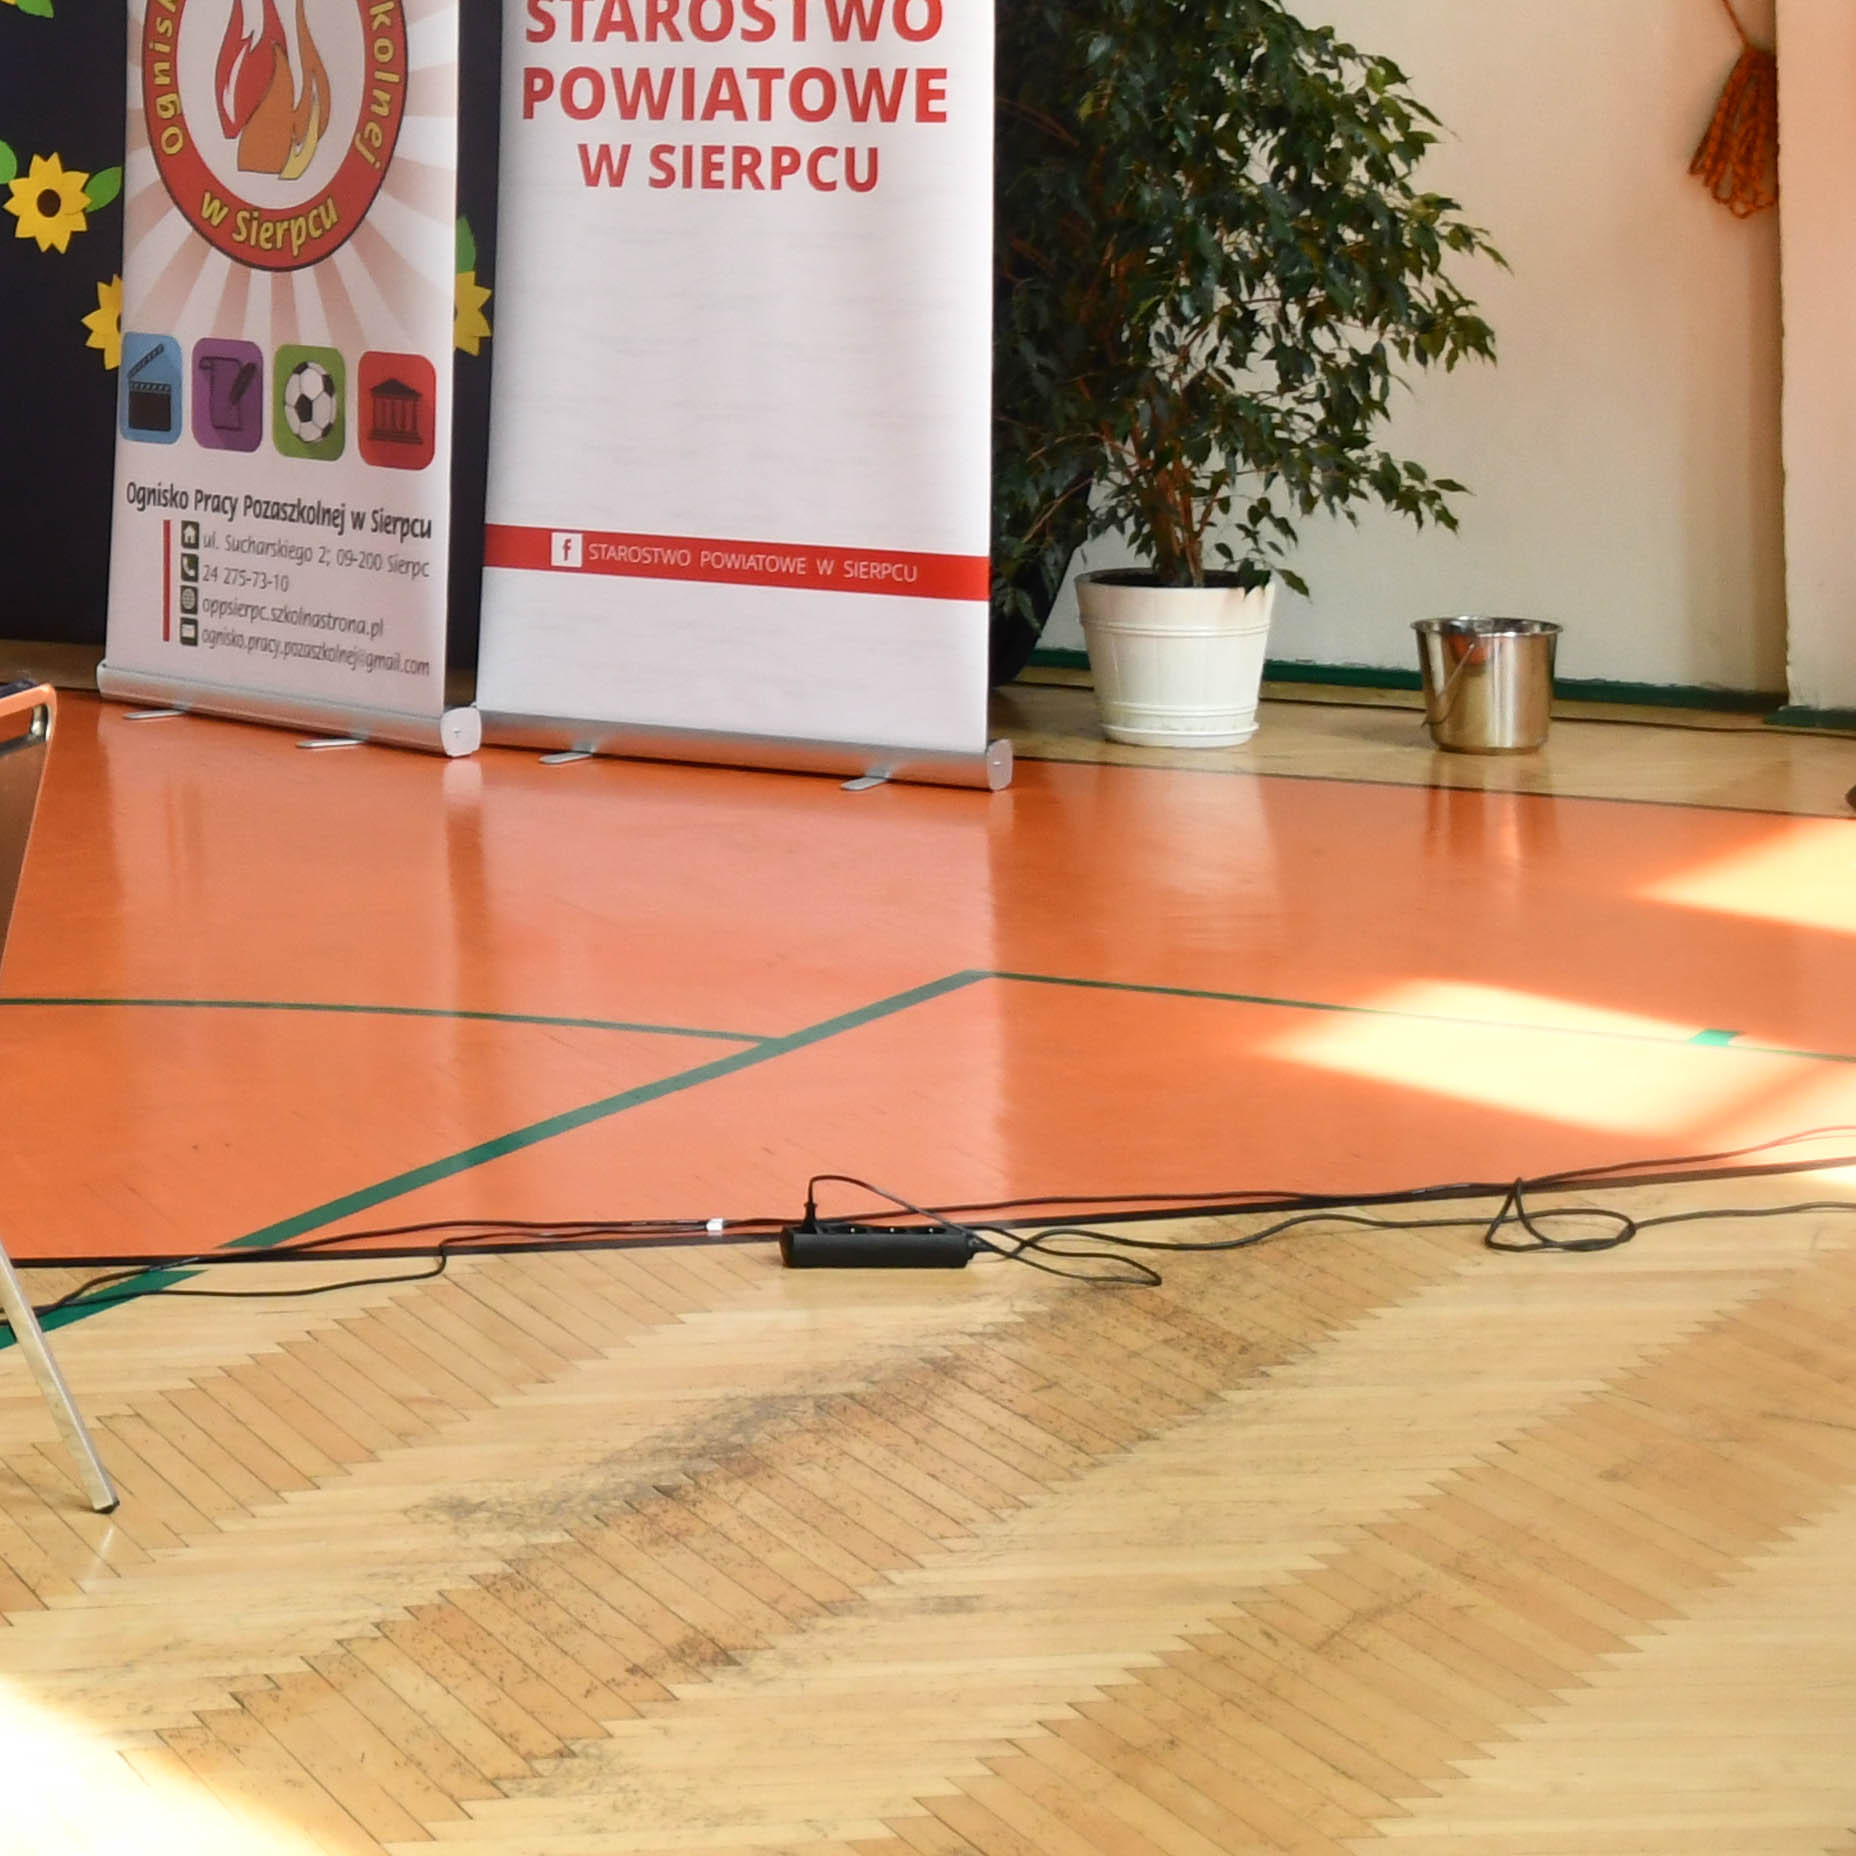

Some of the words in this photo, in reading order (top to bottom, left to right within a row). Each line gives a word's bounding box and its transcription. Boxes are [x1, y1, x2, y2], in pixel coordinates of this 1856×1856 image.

[522, 66, 948, 124] POWIATOWE
[577, 143, 632, 188] W
[647, 143, 879, 193] SIERPCU
[198, 190, 230, 227] w
[232, 194, 340, 257] Sierpcu
[126, 481, 189, 512] Ognisko
[193, 489, 238, 522] Pracy
[243, 494, 346, 536] Pozaszkolnej
[350, 512, 366, 532] w
[370, 508, 433, 543] Sierpcu
[202, 531, 219, 551] ul.
[224, 533, 314, 567] Sucharskiego
[336, 548, 383, 573] 09-200
[387, 553, 431, 581] Sierpc
[202, 564, 218, 583] 24
[223, 566, 290, 592] 275-73-10
[588, 543, 692, 567] STAROSTWO
[699, 550, 807, 575] POWIATOWE
[816, 558, 835, 576] W
[842, 559, 919, 584] SIERPCU
[201, 596, 384, 639] oppsierpc.szkolnastrona.pl
